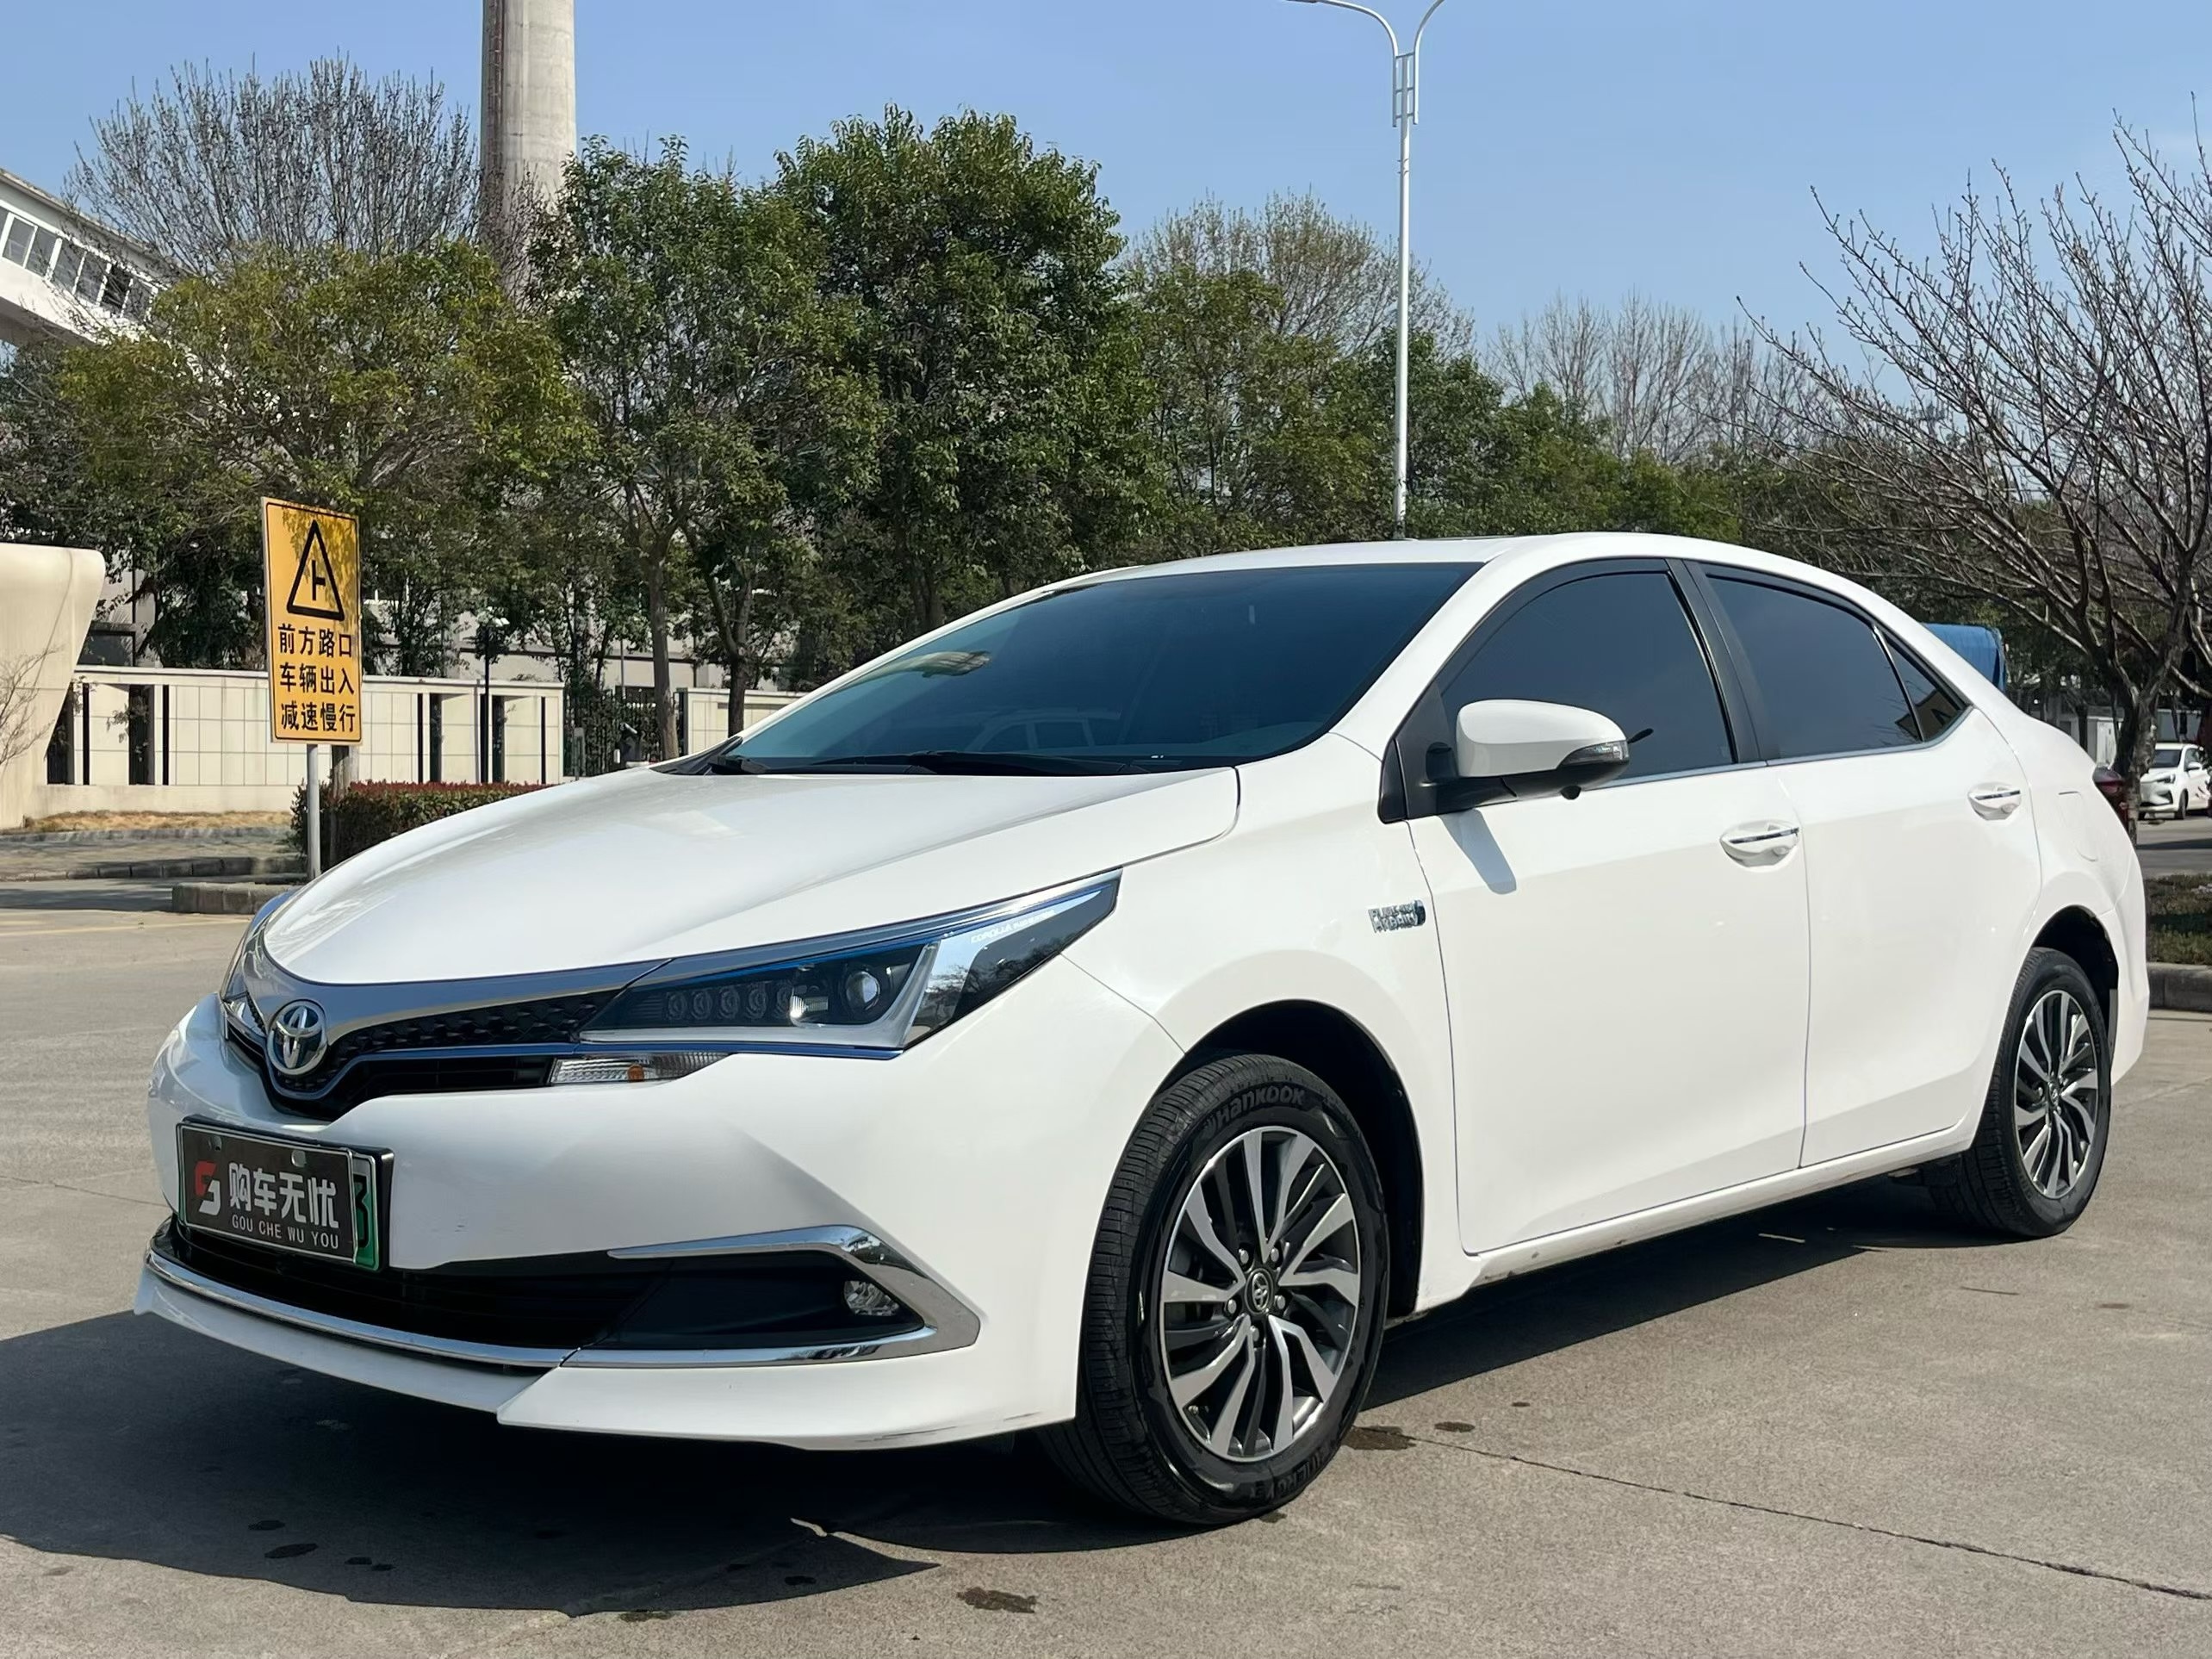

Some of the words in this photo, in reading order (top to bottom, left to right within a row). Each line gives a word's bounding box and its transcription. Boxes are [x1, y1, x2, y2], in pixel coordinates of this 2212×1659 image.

[278, 623, 352, 657] 前方路口
[280, 662, 354, 695] 车辆出入
[281, 700, 356, 732] 减速慢行
[228, 1162, 339, 1228] 购车无忧
[232, 1215, 253, 1233] GOU
[258, 1220, 282, 1239] CHE
[288, 1226, 304, 1243] WU
[312, 1232, 339, 1249] YOU
